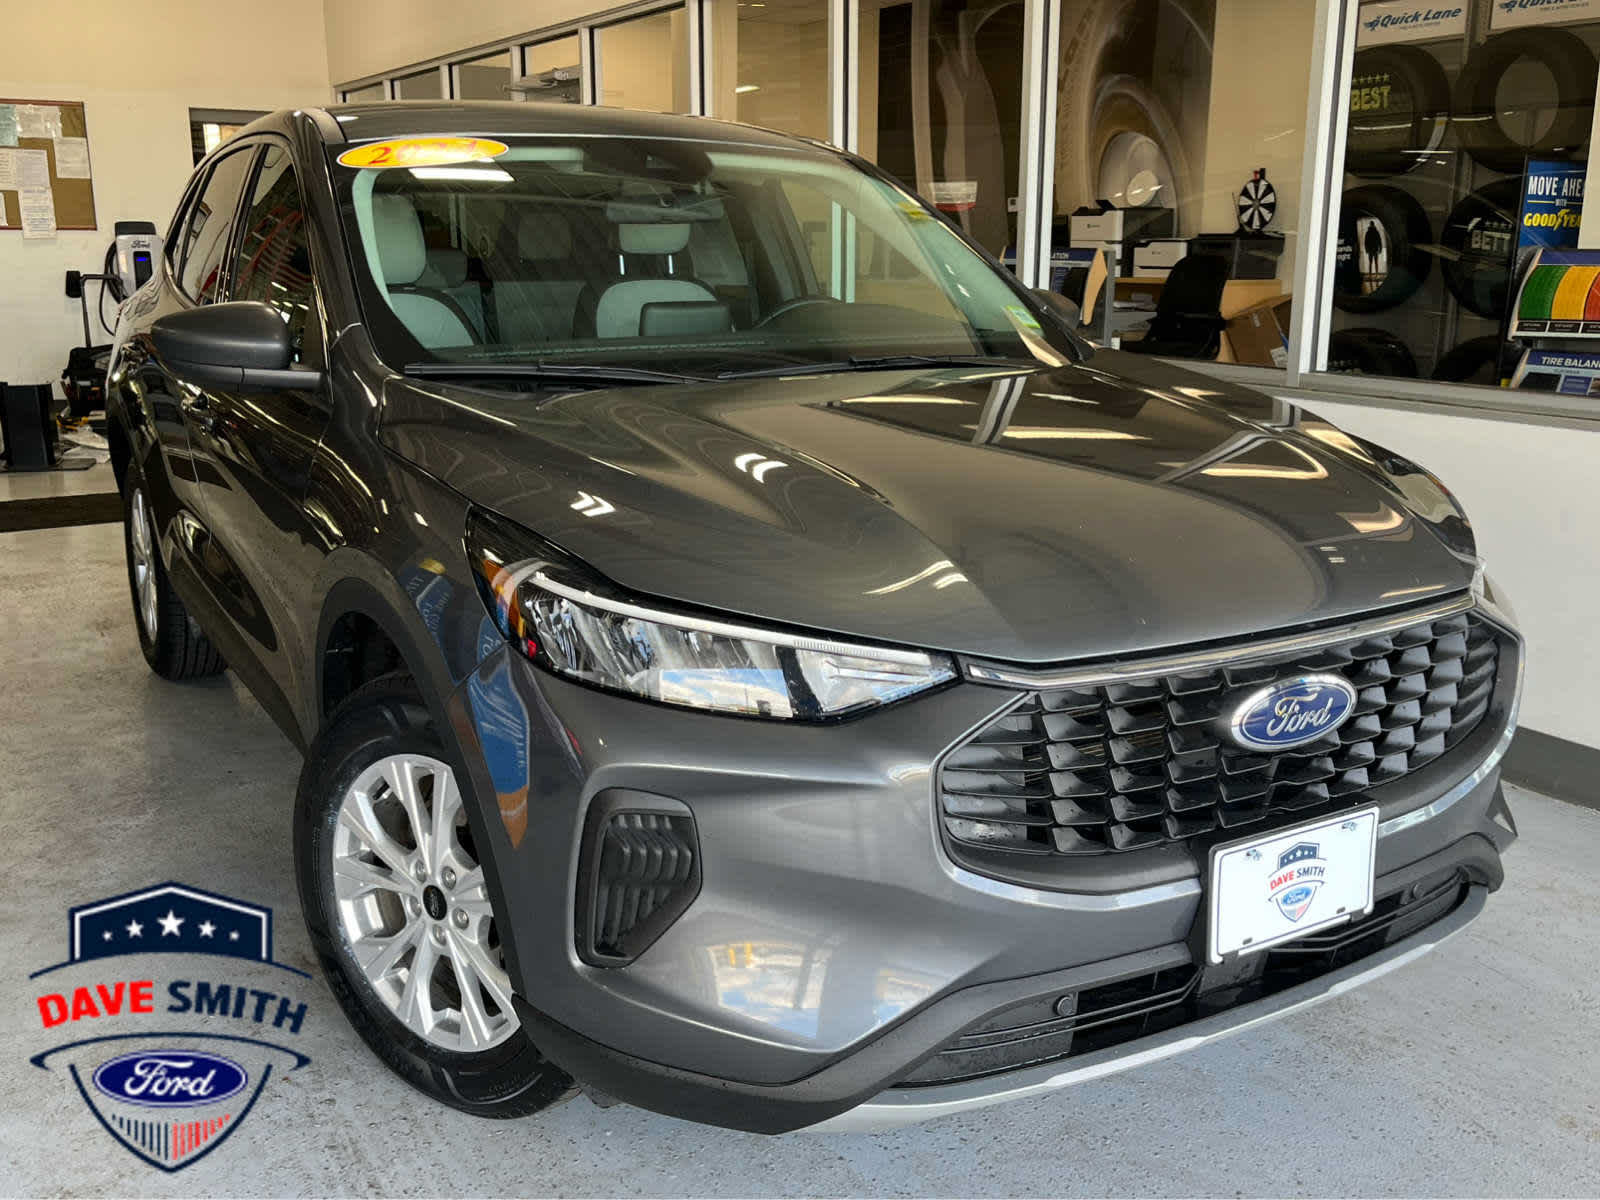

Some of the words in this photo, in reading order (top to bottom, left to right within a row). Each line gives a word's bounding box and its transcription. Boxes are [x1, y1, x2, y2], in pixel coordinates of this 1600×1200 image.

[1381, 11, 1421, 27] Quick
[1423, 8, 1462, 20] Lane
[1351, 86, 1391, 110] BEST
[1528, 175, 1559, 196] MOVE
[1561, 178, 1584, 197] AHE
[1541, 356, 1563, 365] TIRE
[1266, 692, 1334, 737] Ford
[1270, 870, 1295, 891] DAVE
[1296, 866, 1326, 879] SMITH
